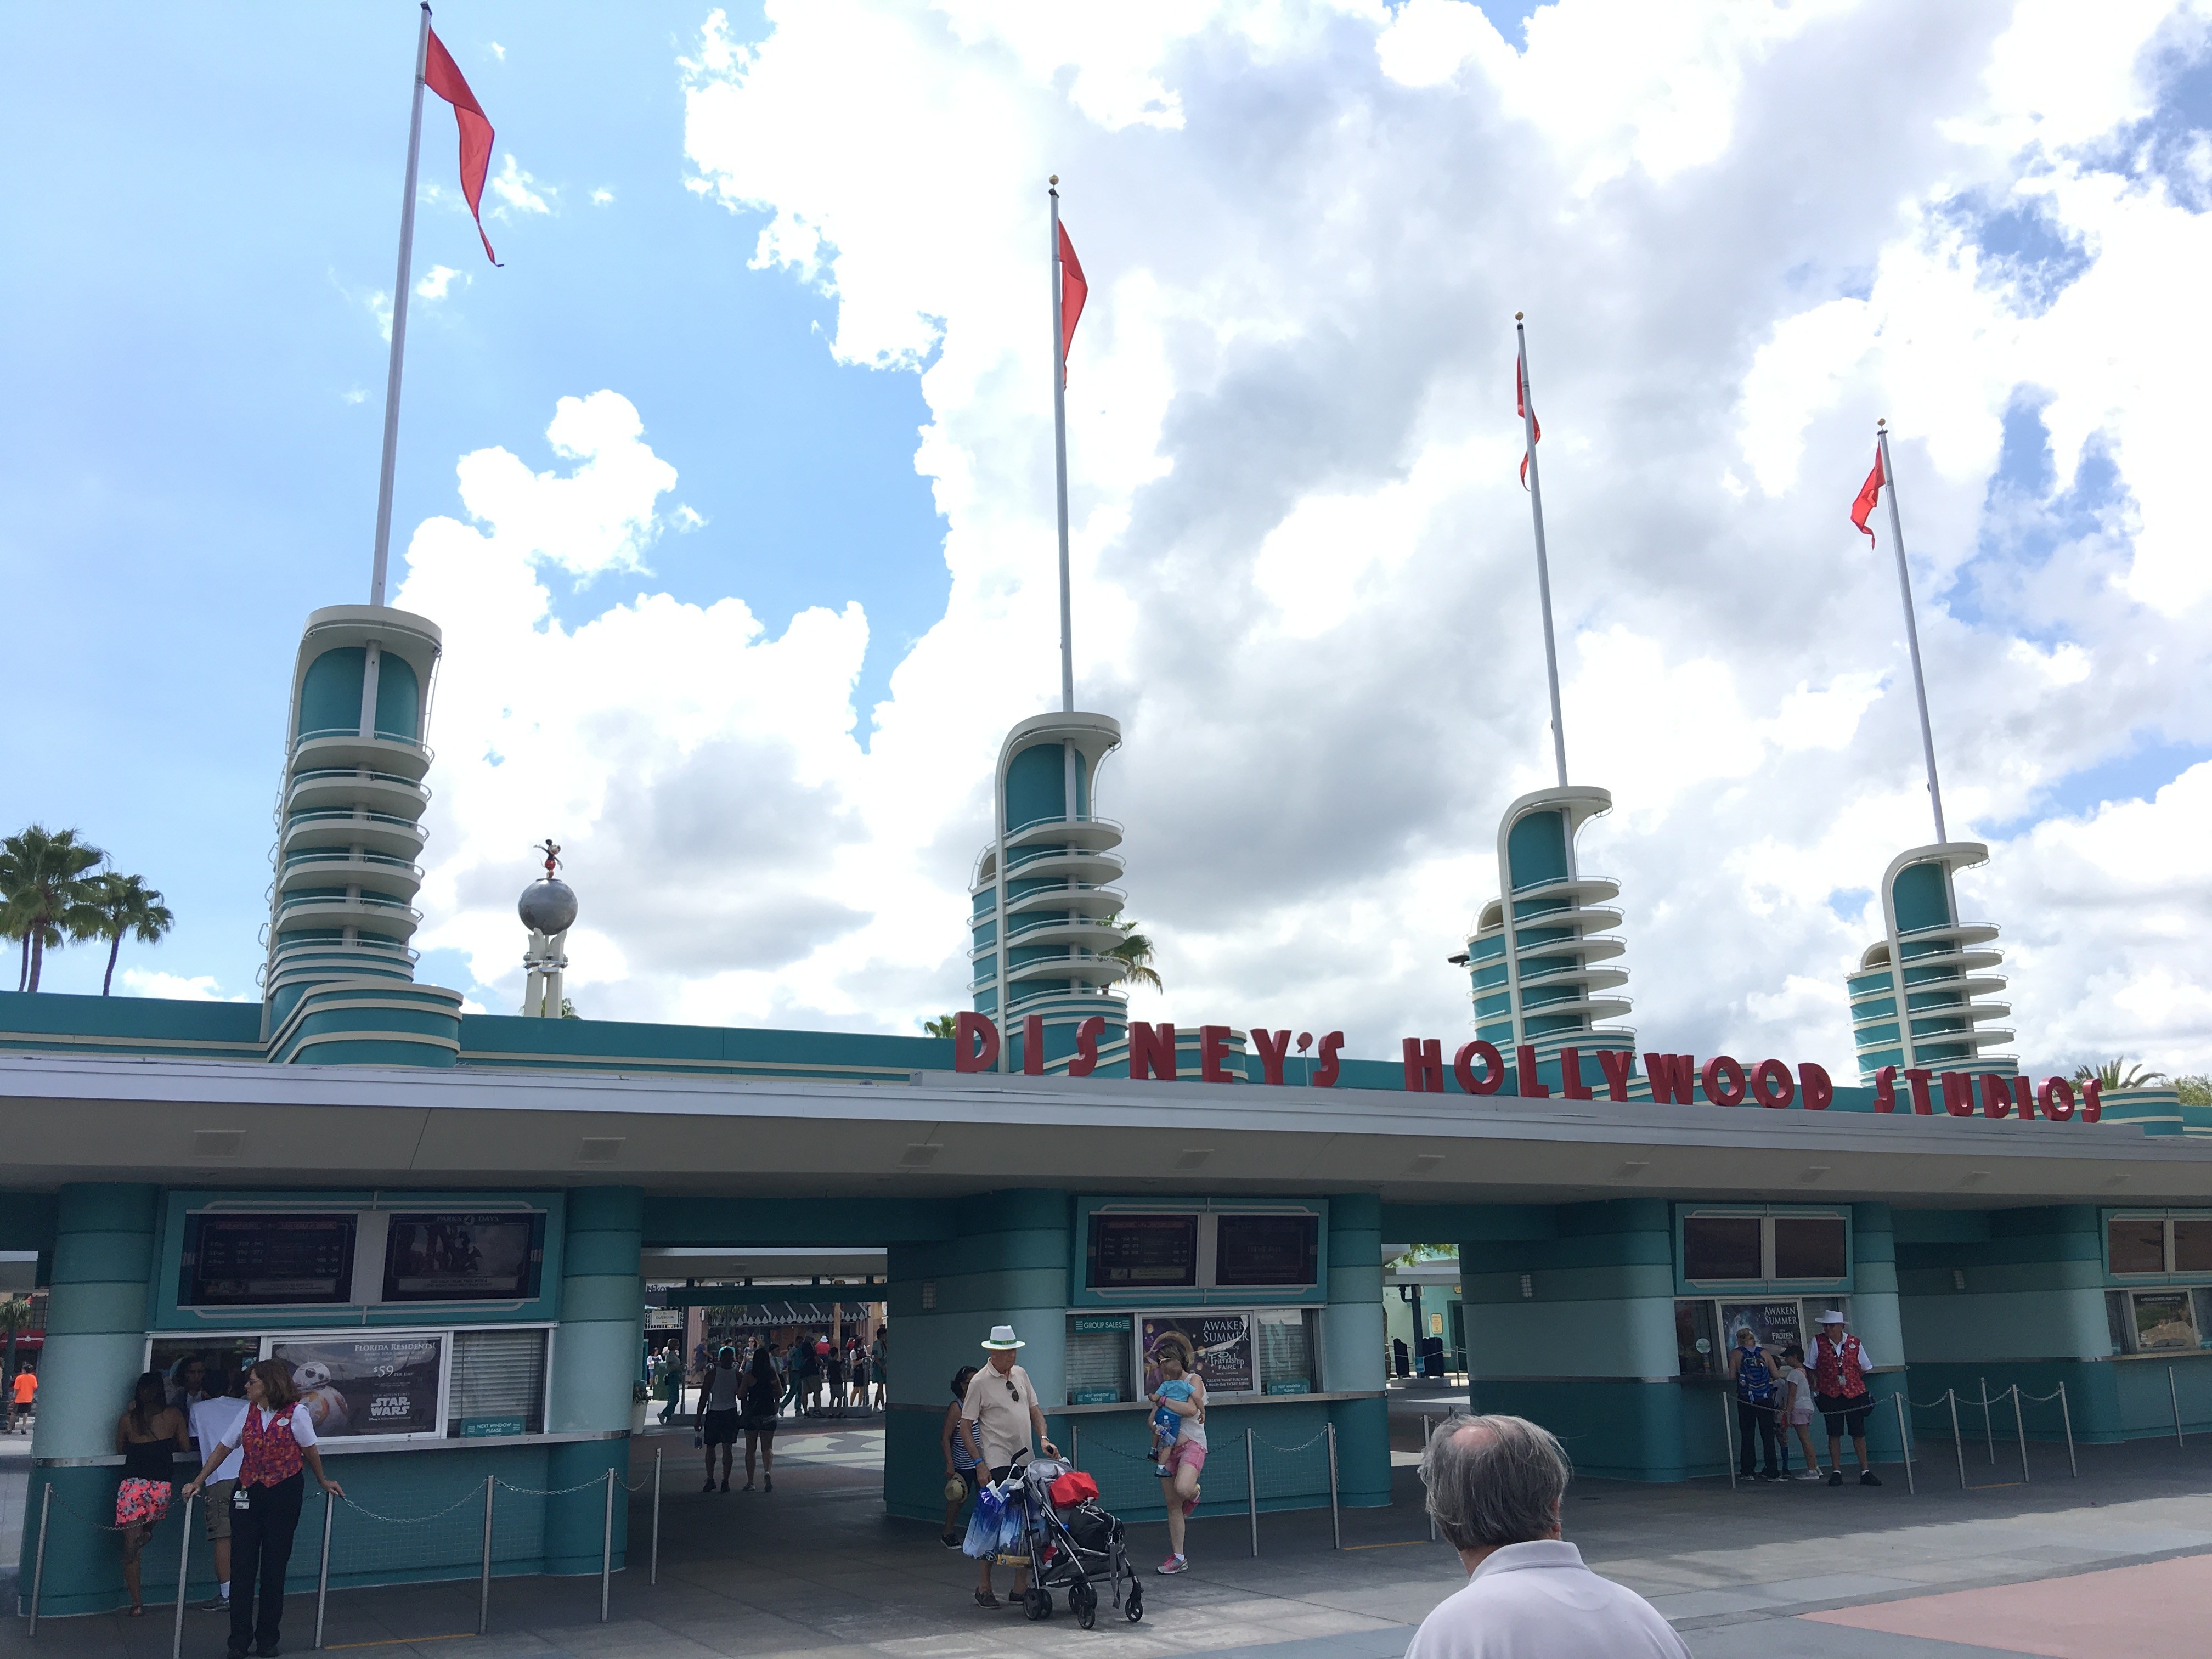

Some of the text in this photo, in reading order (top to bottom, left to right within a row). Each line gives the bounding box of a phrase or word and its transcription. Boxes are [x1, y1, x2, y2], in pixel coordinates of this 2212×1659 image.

[955, 1011, 2103, 1124] DISNEY'S HOLLYWOOD STUDIOS
[1764, 1306, 1796, 1316] AWAKEN
[1203, 1320, 1246, 1331] AWAKEN
[1764, 1316, 1798, 1325] SUMMER
[1204, 1331, 1249, 1342] SUMMER
[1771, 1331, 1794, 1340] FROZEN
[354, 1344, 389, 1352] FLORIDA
[373, 1365, 394, 1378] $59
[370, 1397, 411, 1407] STAR
[370, 1406, 410, 1416] WARS
